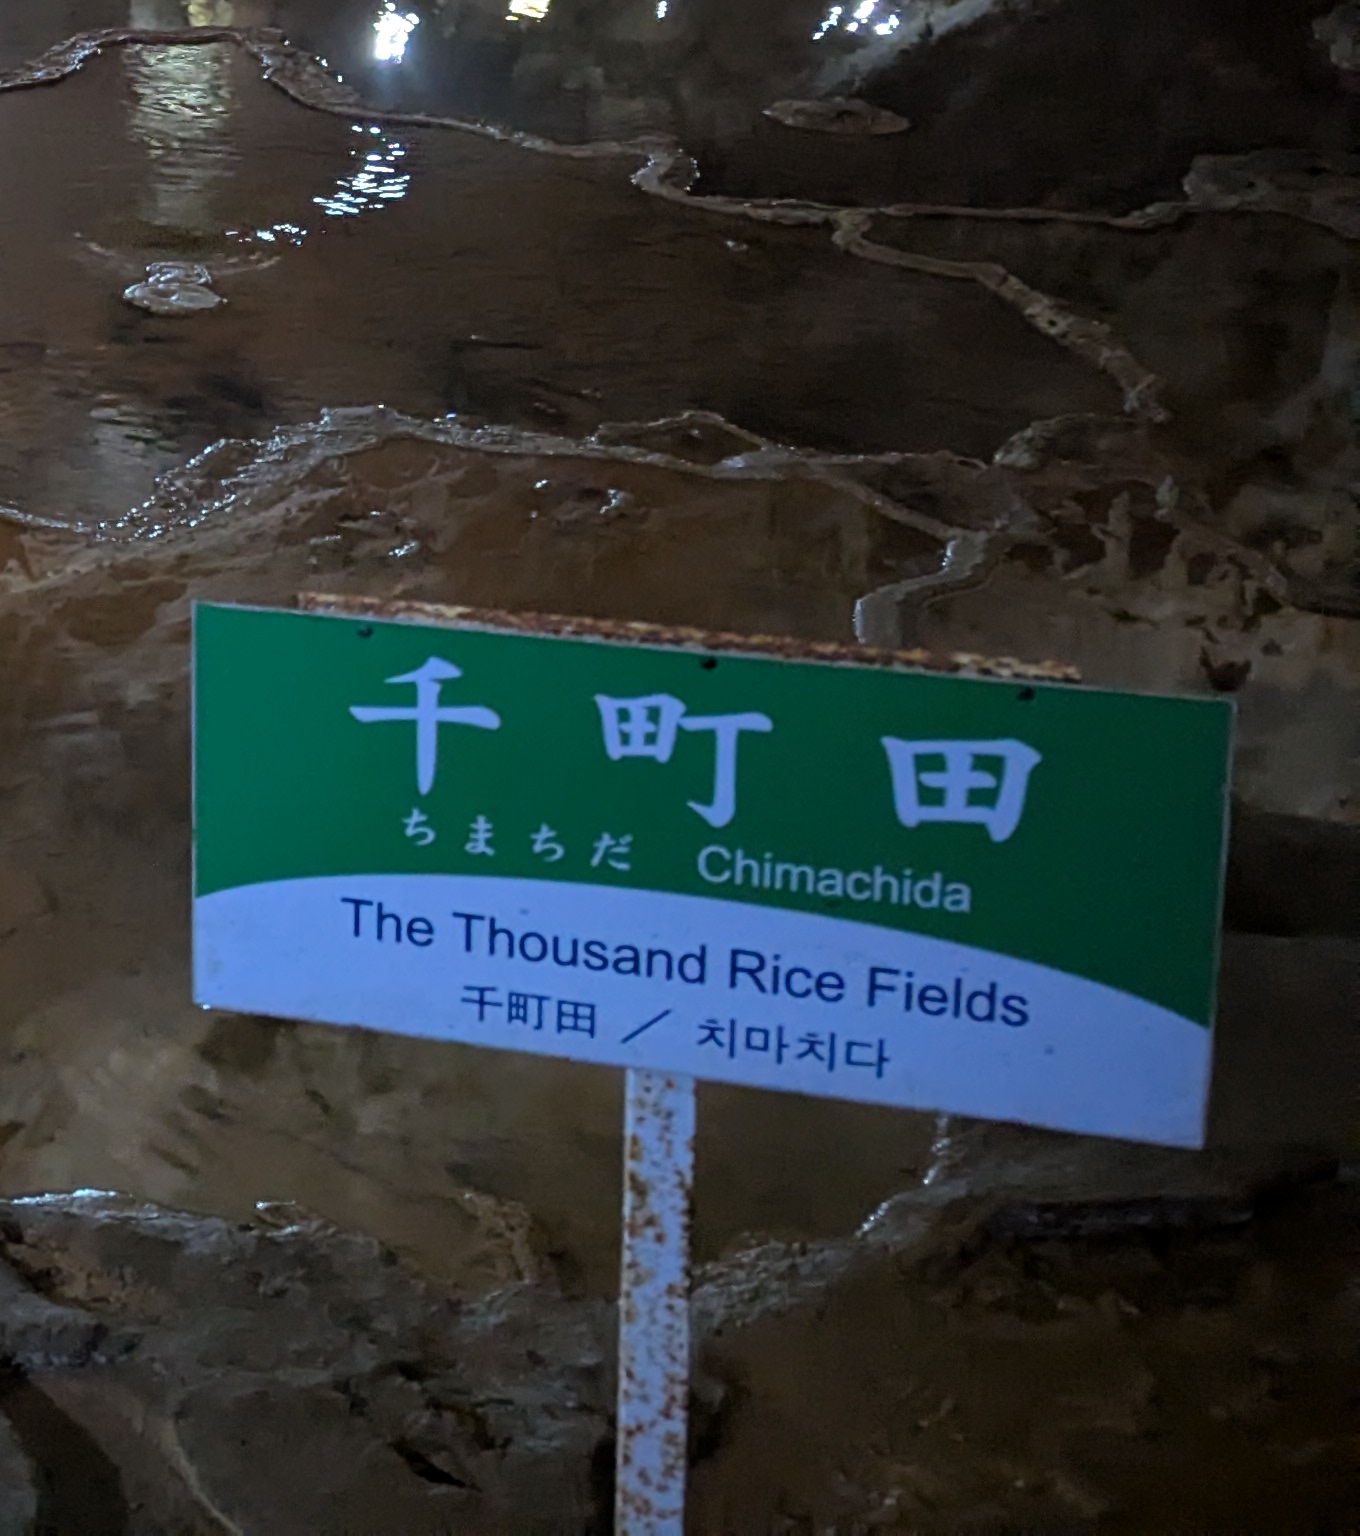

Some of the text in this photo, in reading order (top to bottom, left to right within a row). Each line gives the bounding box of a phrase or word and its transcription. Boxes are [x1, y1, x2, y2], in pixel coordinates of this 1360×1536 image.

[348, 655, 1043, 843] 千町田
[400, 806, 972, 913] ちまちだ Chimachida
[340, 896, 1030, 1028] The Thousand Rice Fields
[460, 984, 597, 1039] 千町田
[696, 1017, 891, 1080] 치마치다
